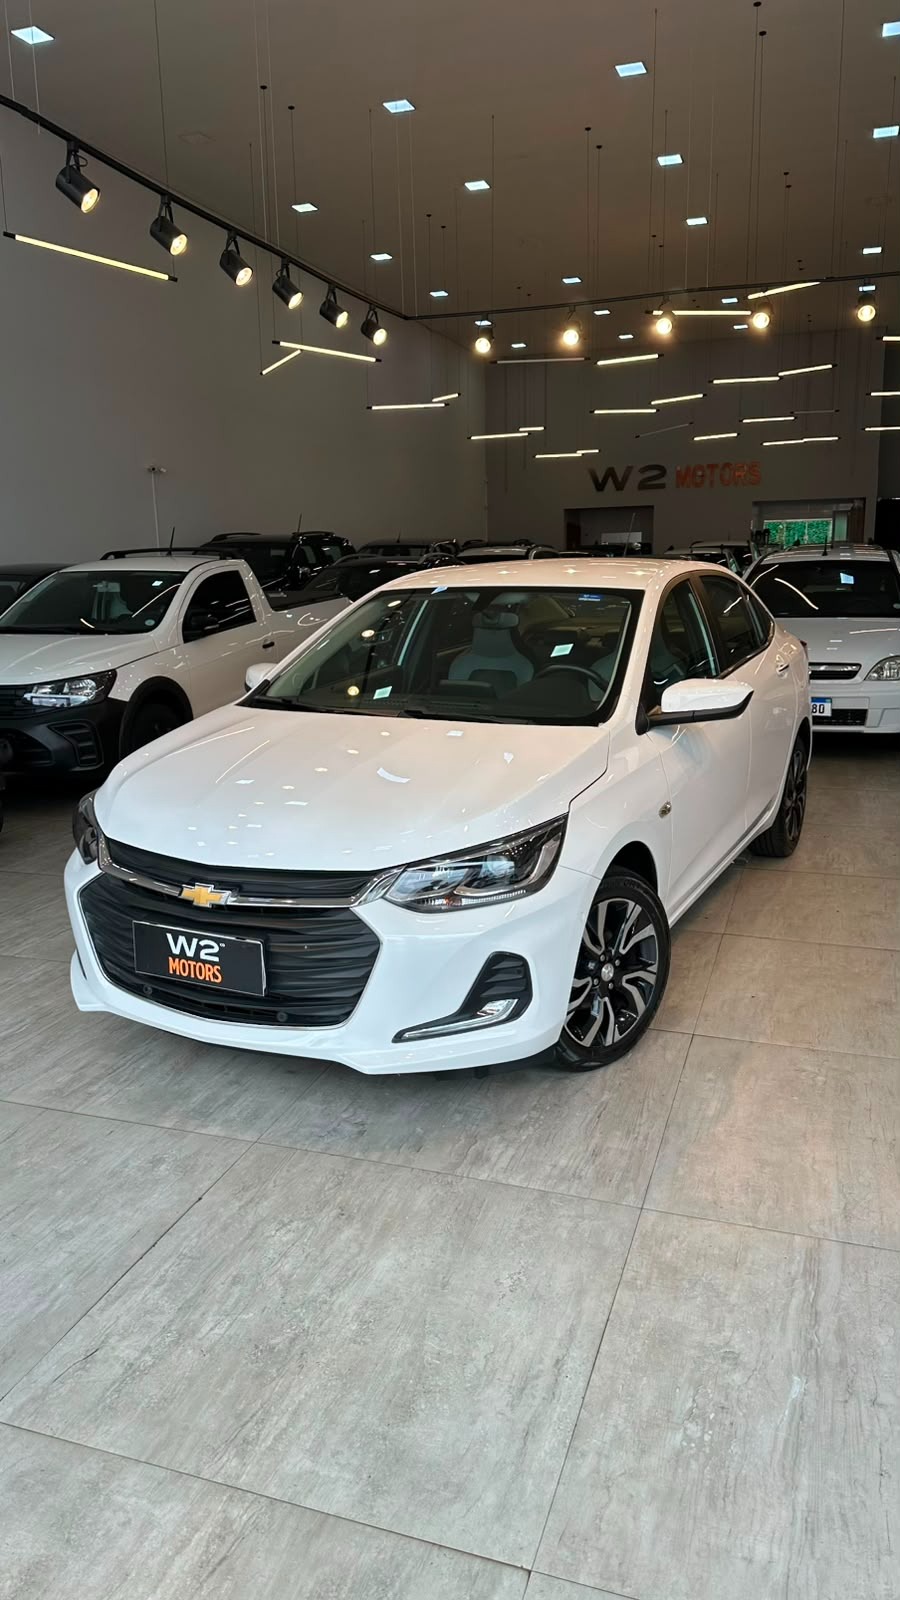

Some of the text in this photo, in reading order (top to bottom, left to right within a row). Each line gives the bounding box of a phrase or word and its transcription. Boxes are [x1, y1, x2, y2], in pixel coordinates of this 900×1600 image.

[588, 461, 762, 492] W2 MOTORS
[166, 933, 219, 962] W2
[168, 957, 222, 983] MOTORS
